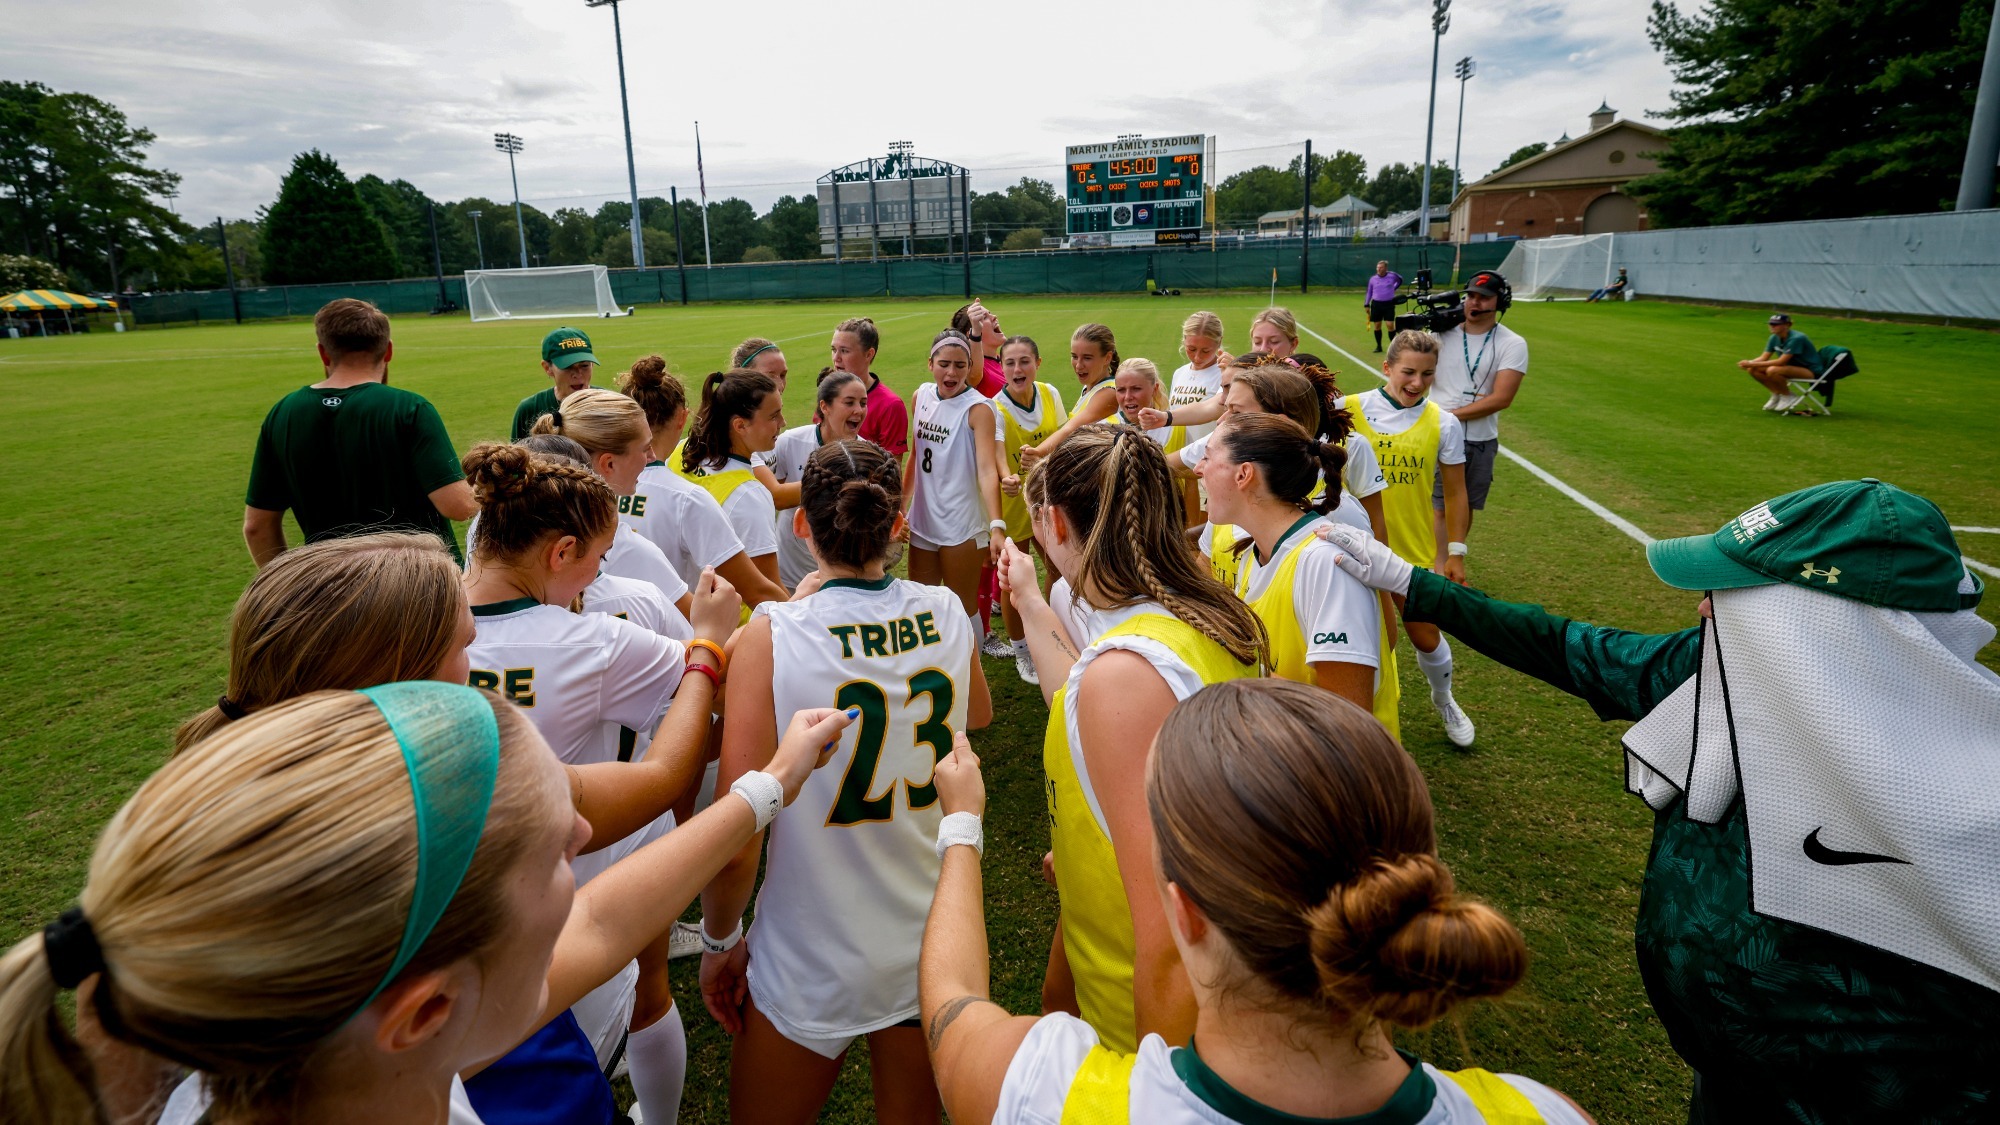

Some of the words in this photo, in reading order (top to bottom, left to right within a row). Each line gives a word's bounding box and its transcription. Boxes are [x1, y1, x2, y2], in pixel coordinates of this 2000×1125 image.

[1070, 144, 1108, 155] MARTIN
[1112, 140, 1149, 151] FAMILY
[1151, 136, 1200, 148] STADIUM
[1108, 150, 1147, 159] ALBERT-DALY
[1071, 163, 1092, 171] TRIBE
[1110, 157, 1156, 175] 45:00
[1191, 162, 1199, 175] 0
[1078, 171, 1086, 184] 0
[1163, 178, 1181, 187] SHOTS
[558, 340, 588, 349] TRIBE
[1173, 386, 1207, 396] WILLIAM
[918, 419, 950, 436] WILLIAM
[921, 447, 933, 473] 8
[1378, 454, 1424, 469] LIAM
[827, 610, 941, 660] TRIBE
[1313, 631, 1349, 644] CAA
[824, 667, 956, 827] 23
